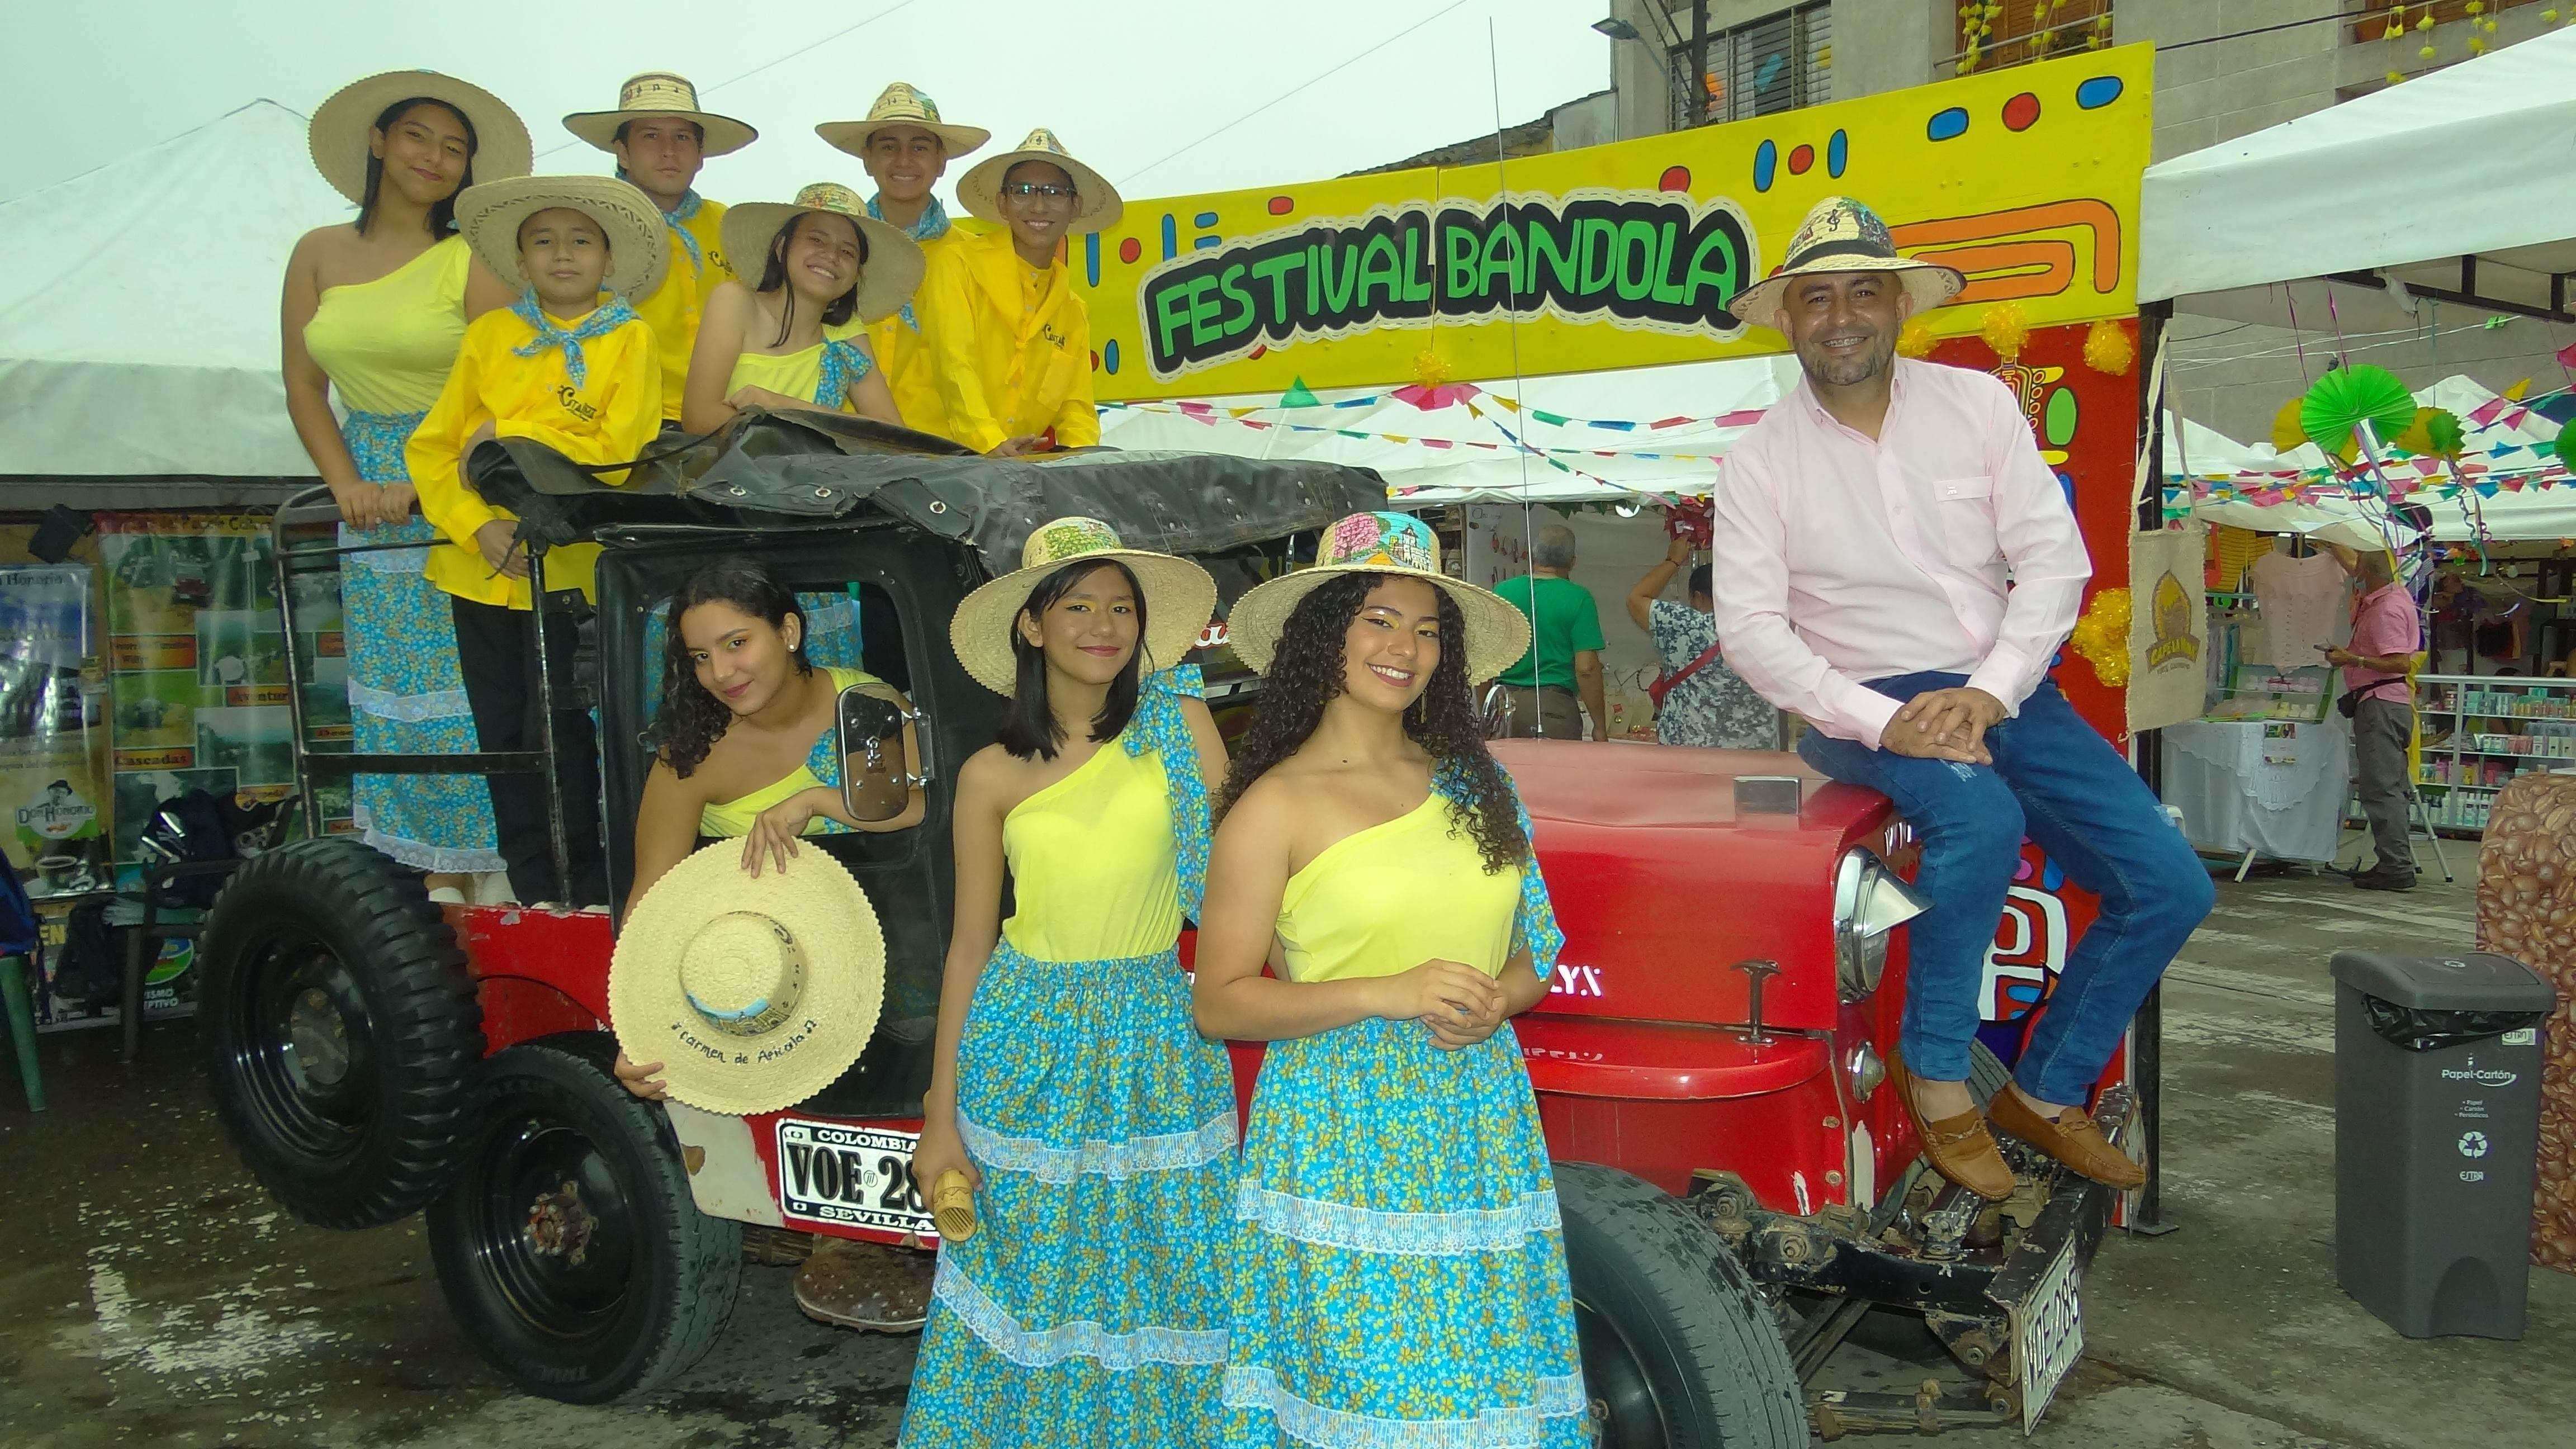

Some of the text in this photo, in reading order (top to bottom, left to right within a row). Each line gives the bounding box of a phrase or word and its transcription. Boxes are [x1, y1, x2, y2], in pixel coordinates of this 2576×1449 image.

[1154, 218, 1737, 359] FESTIVAL BANDOLA
[735, 1053, 748, 1064] de
[787, 1143, 926, 1214] VOE 28
[820, 1206, 936, 1232] SEVILLA
[2026, 1300, 2052, 1391] VOE
